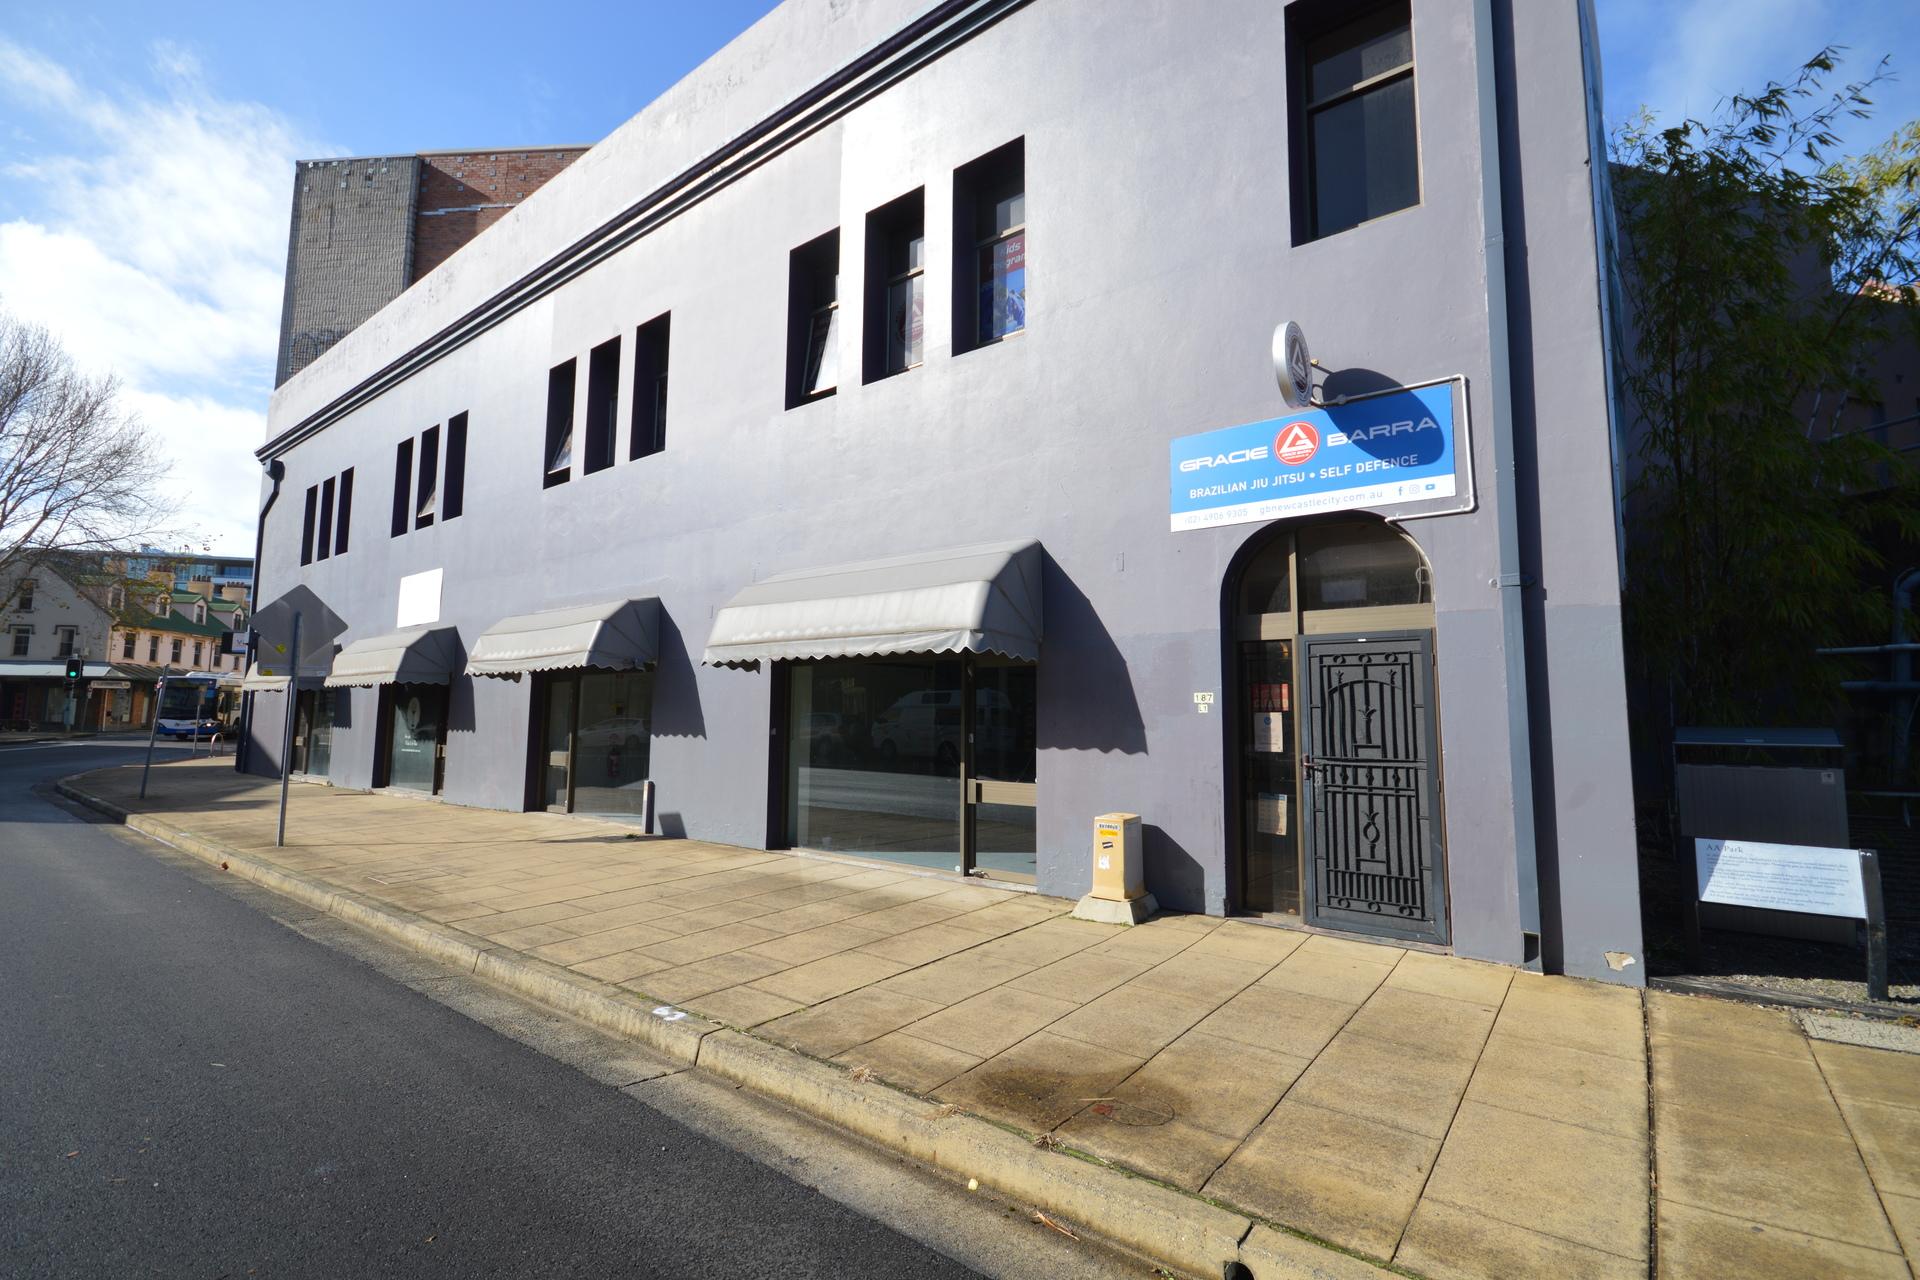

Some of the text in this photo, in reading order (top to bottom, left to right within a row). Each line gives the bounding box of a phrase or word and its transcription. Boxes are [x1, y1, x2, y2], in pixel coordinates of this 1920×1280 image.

[1180, 417, 1437, 472] GRACIE BARRA
[1190, 454, 1418, 499] BRAZILIAN JIU JITSU SELF DEFENCE
[1195, 694, 1212, 702] 187
